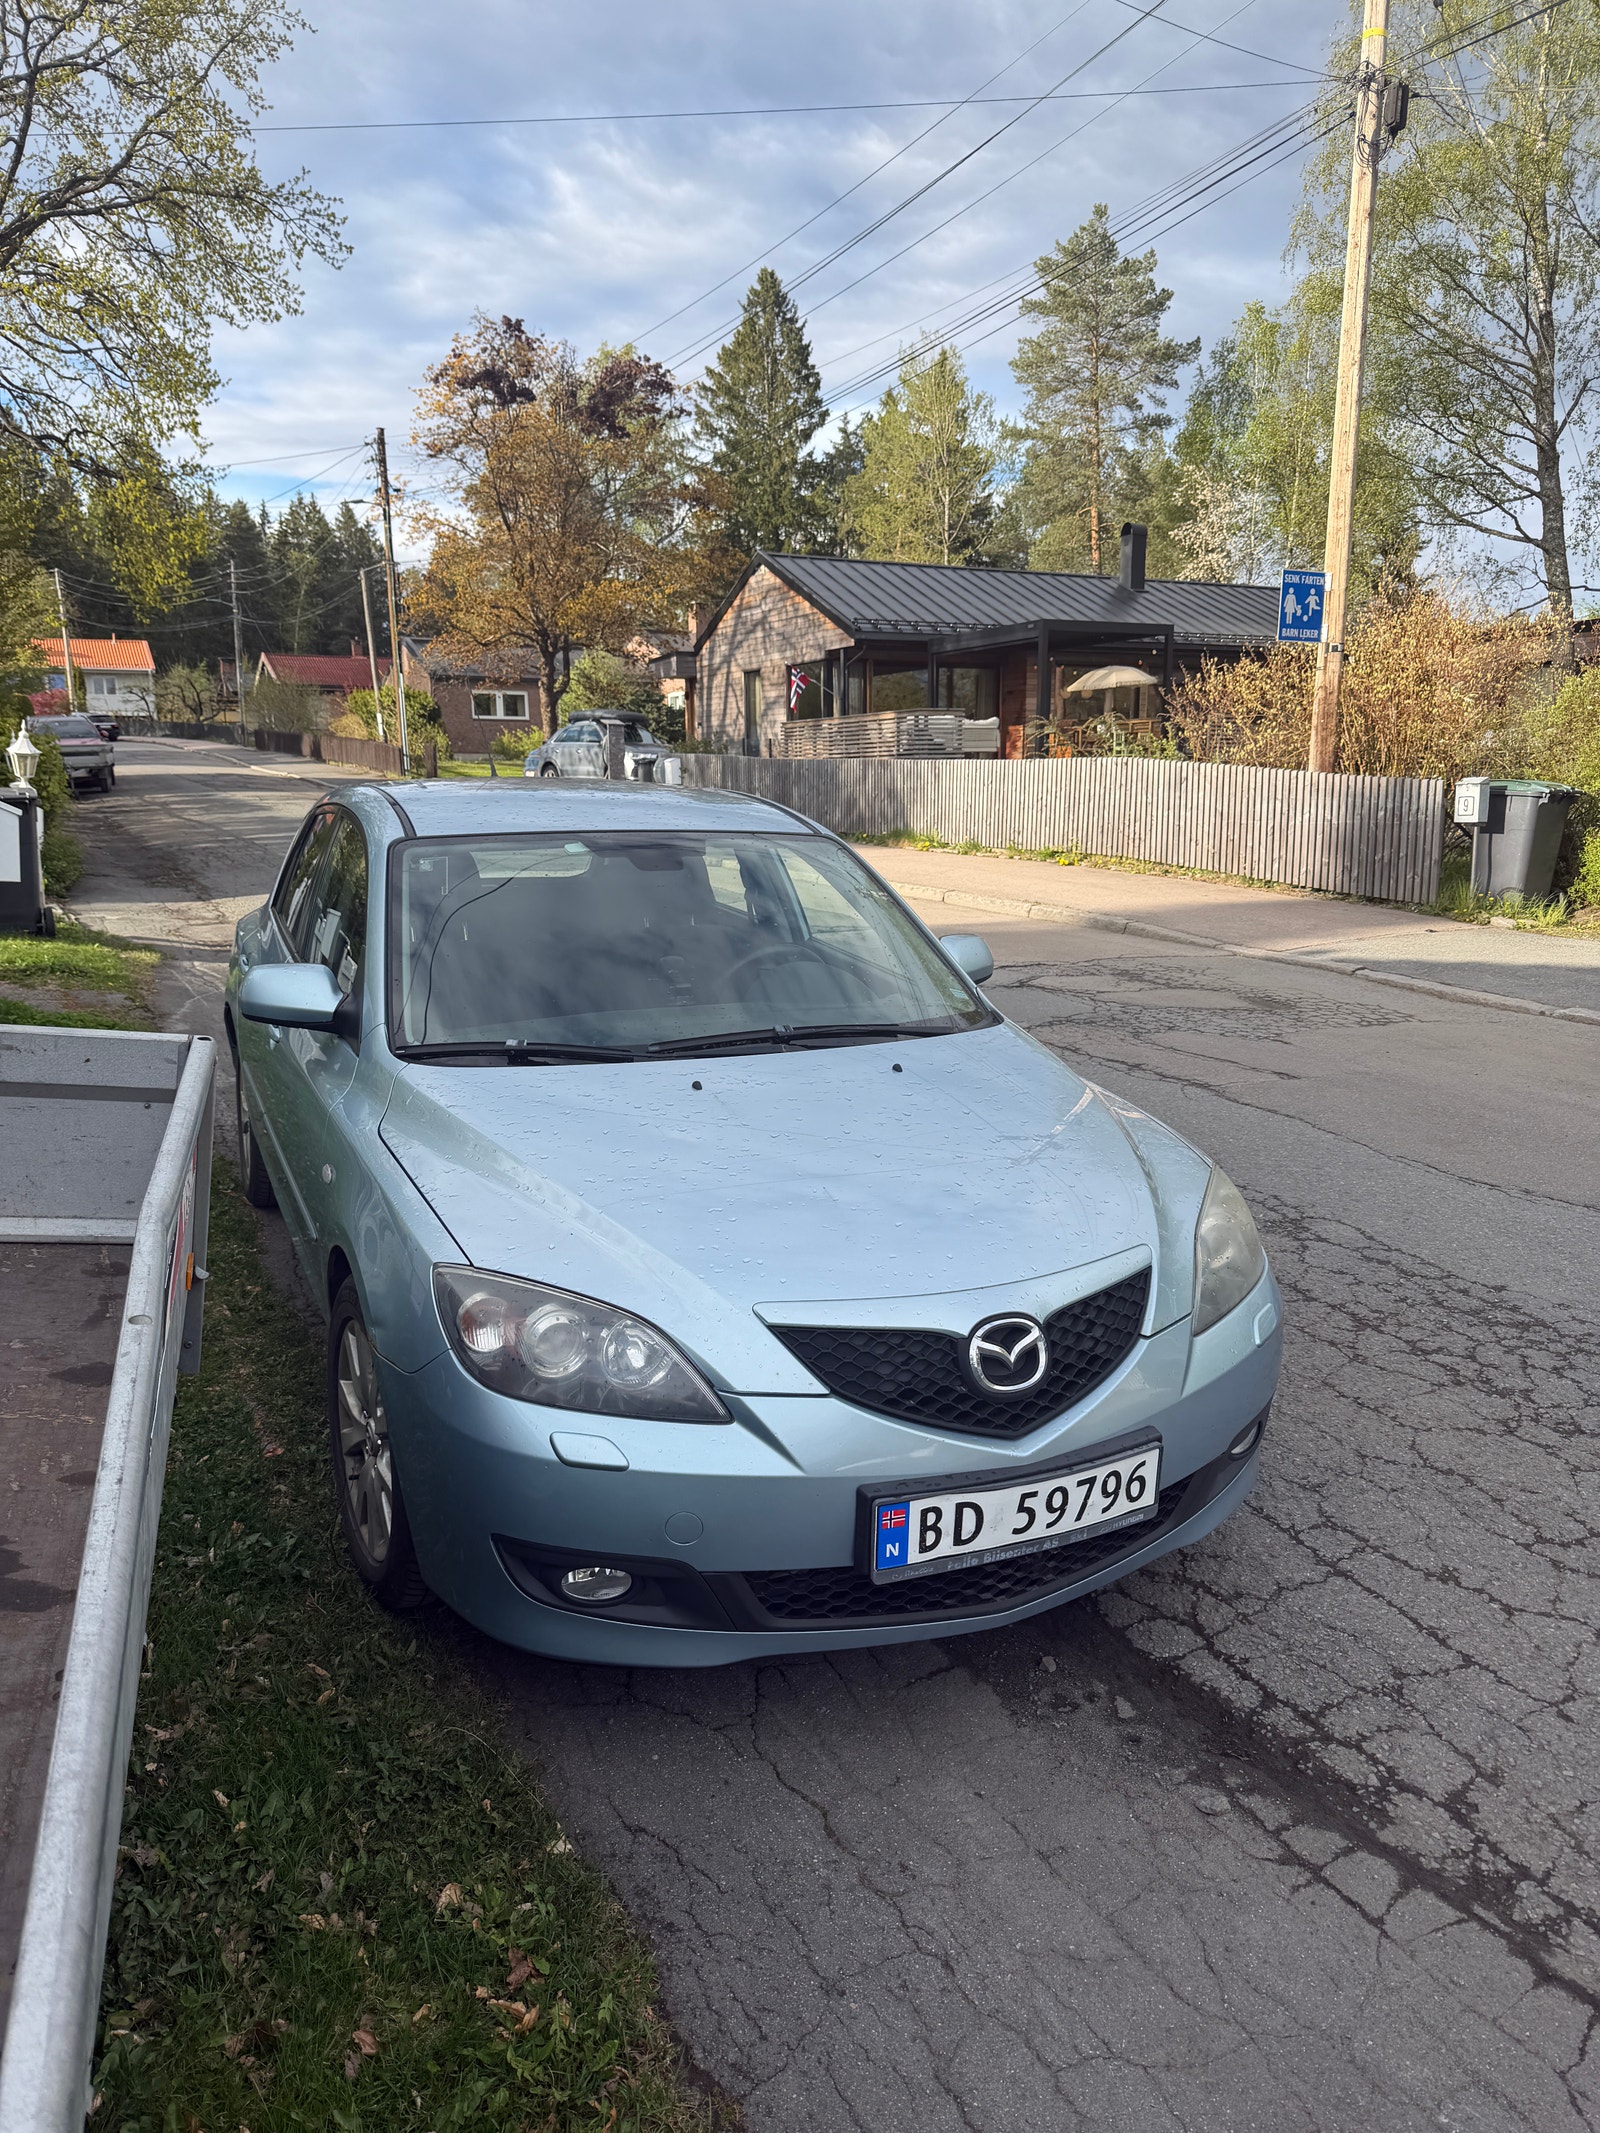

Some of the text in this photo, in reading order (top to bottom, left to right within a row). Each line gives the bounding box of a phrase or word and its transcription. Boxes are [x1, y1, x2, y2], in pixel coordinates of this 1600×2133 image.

[1284, 574, 1300, 583] SENK
[1282, 628, 1318, 638] BARN LEKER
[1463, 798, 1469, 812] 9
[918, 1460, 1147, 1554] BD 59796
[885, 1542, 899, 1558] N
